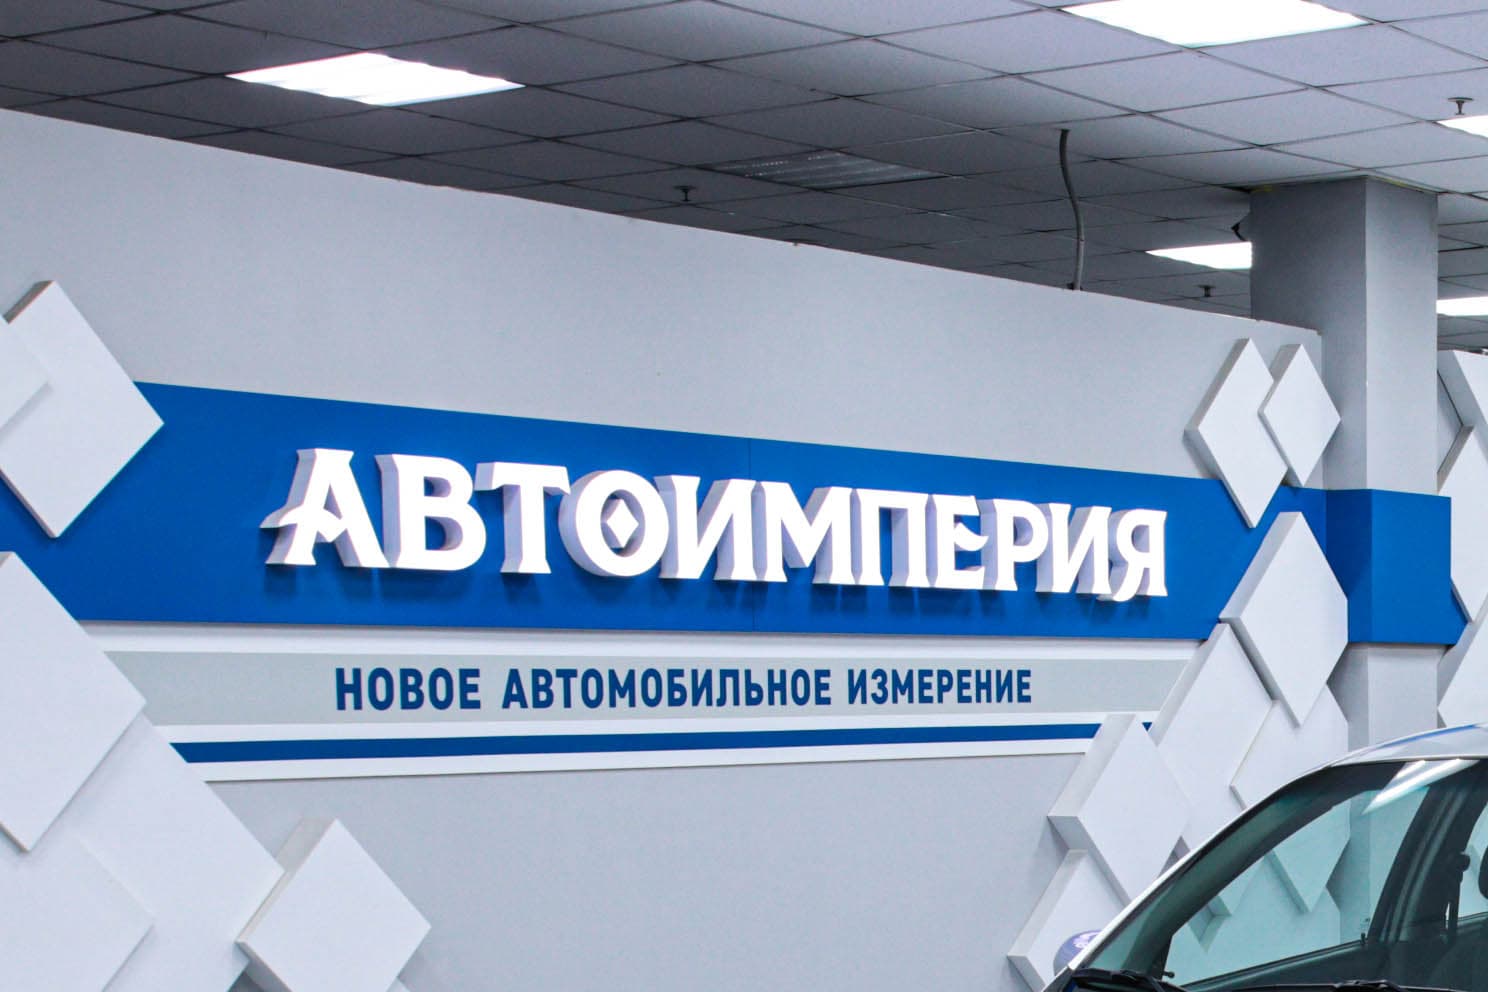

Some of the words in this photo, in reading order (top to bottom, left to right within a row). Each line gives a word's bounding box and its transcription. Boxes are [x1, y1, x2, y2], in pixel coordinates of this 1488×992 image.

[260, 447, 1169, 603] АВТОИМПЕРИЯ
[334, 666, 482, 712] НОВОЕ
[501, 667, 832, 710] АВТОМОБИЛЬНОЕ
[847, 667, 1033, 705] ИЗМЕРЕНИЕ
